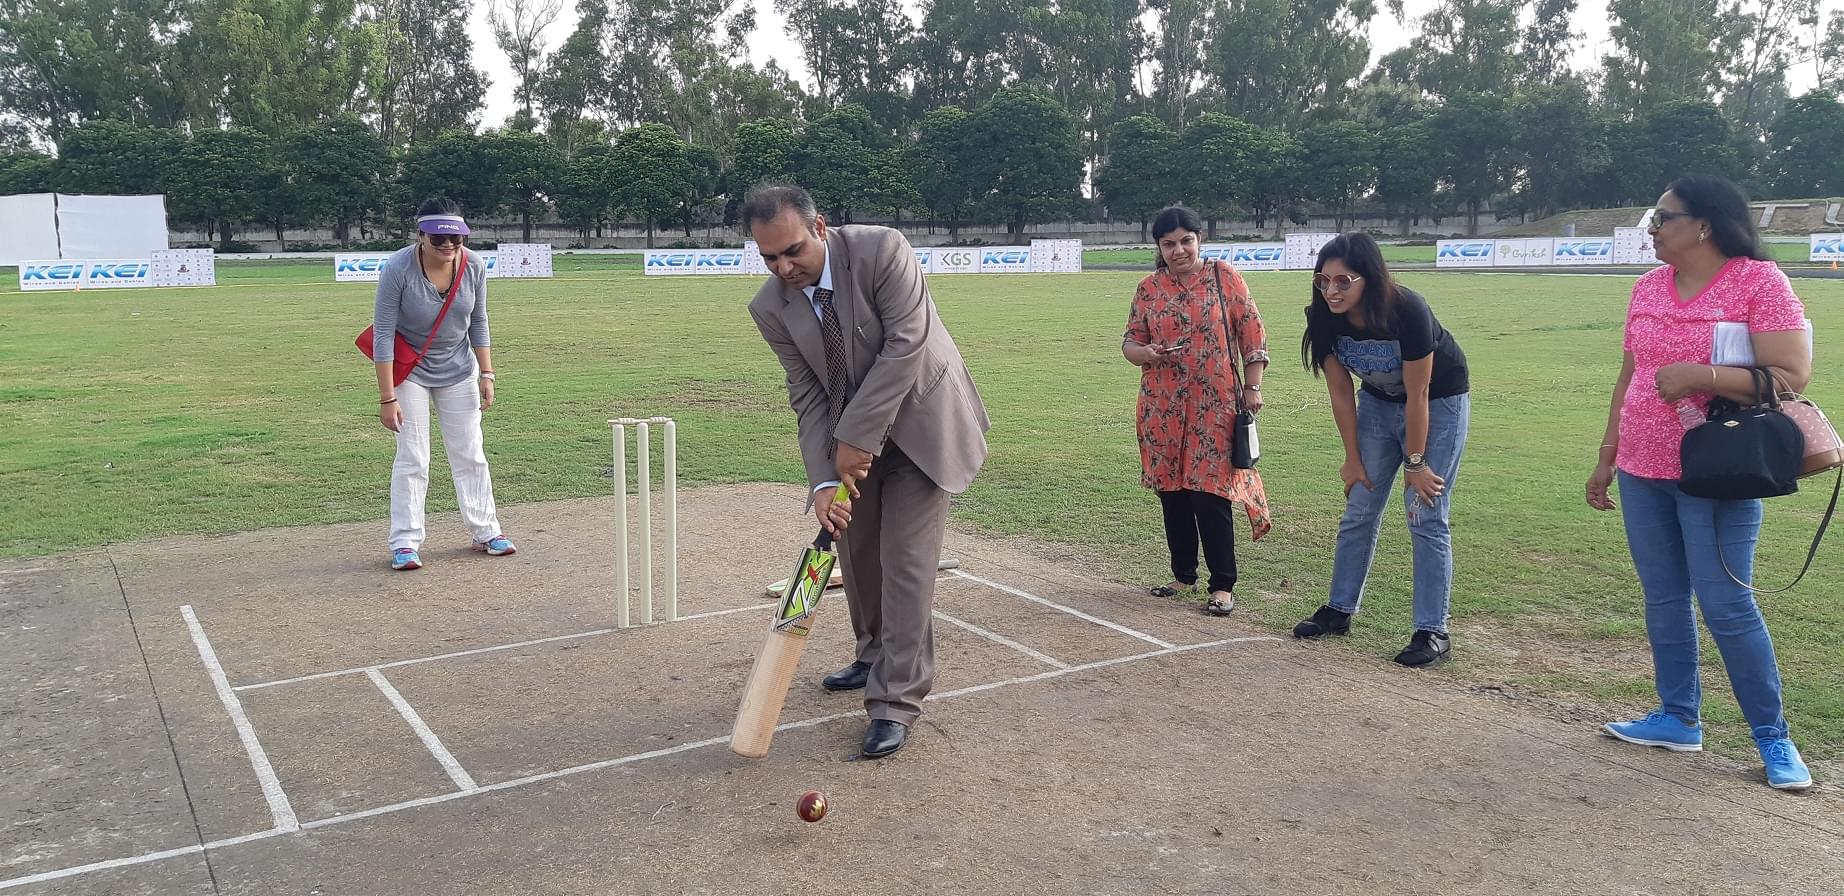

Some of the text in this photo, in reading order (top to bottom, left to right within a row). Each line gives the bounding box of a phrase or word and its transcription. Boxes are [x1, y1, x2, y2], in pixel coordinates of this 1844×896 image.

[1233, 248, 1283, 261] KEI
[1439, 243, 1493, 257] KEI
[1556, 242, 1612, 256] KEI
[648, 254, 694, 266] KEI
[697, 254, 742, 266] KEI
[982, 251, 1029, 264] KEI
[23, 264, 83, 280] KEI
[89, 264, 149, 278] KEI
